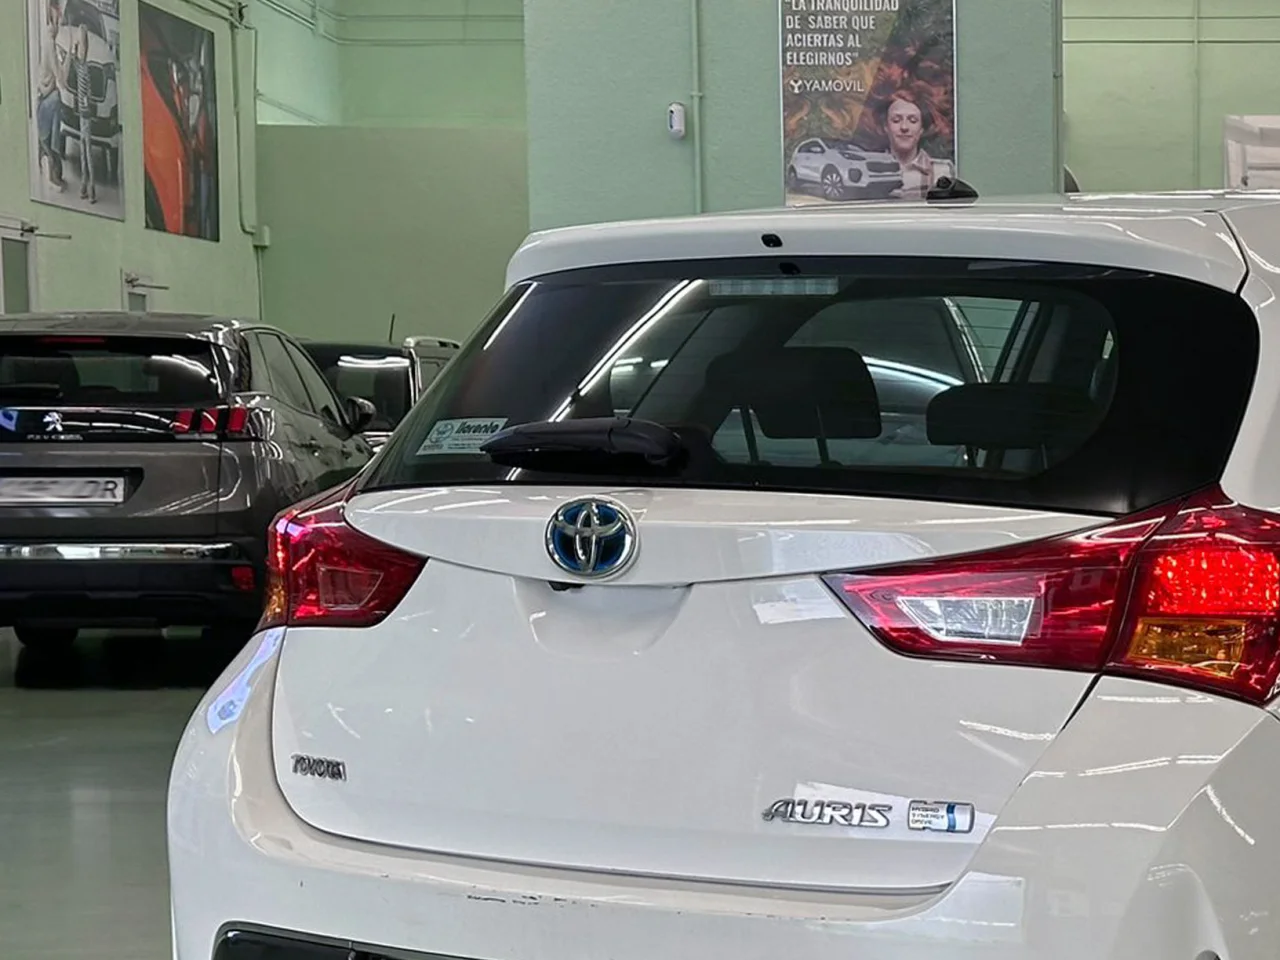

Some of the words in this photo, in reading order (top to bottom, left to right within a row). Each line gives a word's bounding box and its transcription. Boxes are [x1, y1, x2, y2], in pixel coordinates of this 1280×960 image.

[811, 0, 899, 13] TRANQUILIDAD
[786, 15, 801, 29] DE
[808, 15, 848, 30] SABER
[852, 15, 876, 31] QUE
[786, 33, 844, 47] ACIERTAS
[847, 34, 862, 47] AL
[804, 79, 865, 92] YAMOVIL
[762, 799, 892, 828] AURIS
